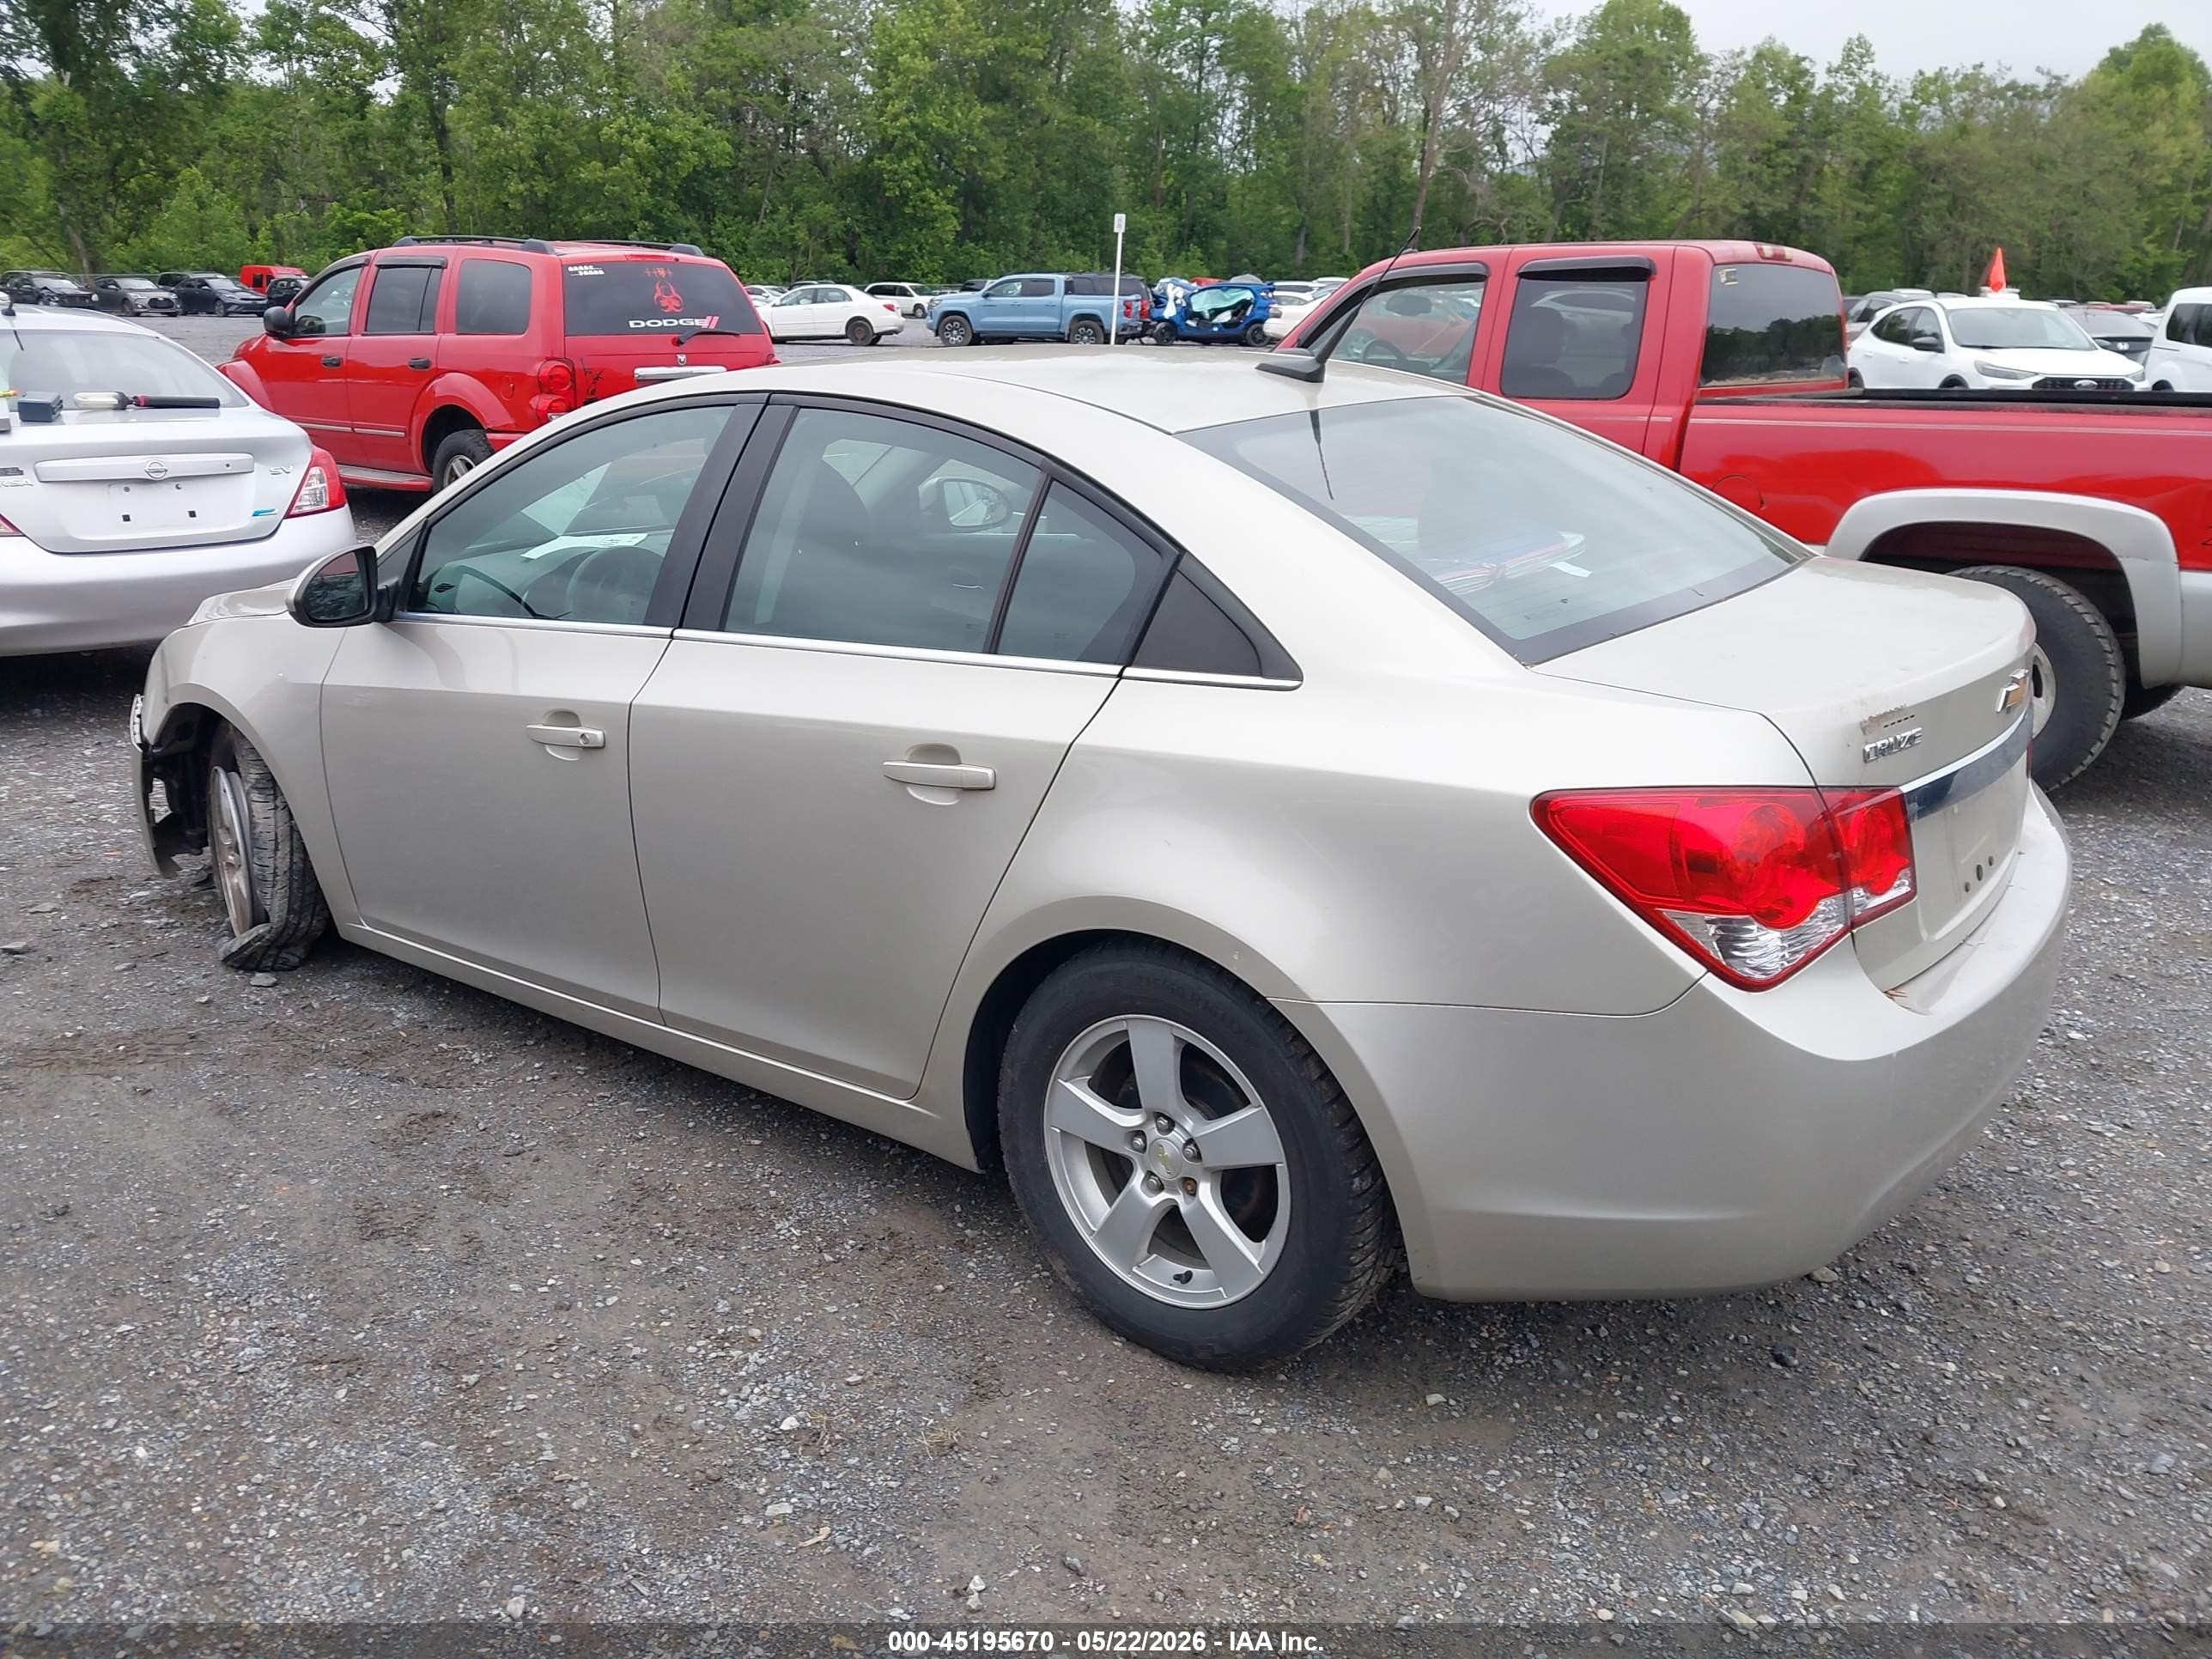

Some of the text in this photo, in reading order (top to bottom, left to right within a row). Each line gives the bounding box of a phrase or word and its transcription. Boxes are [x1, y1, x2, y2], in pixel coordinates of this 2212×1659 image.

[629, 318, 708, 328] DODGE
[268, 465, 293, 477] SV
[1863, 727, 1923, 763] CRUZE
